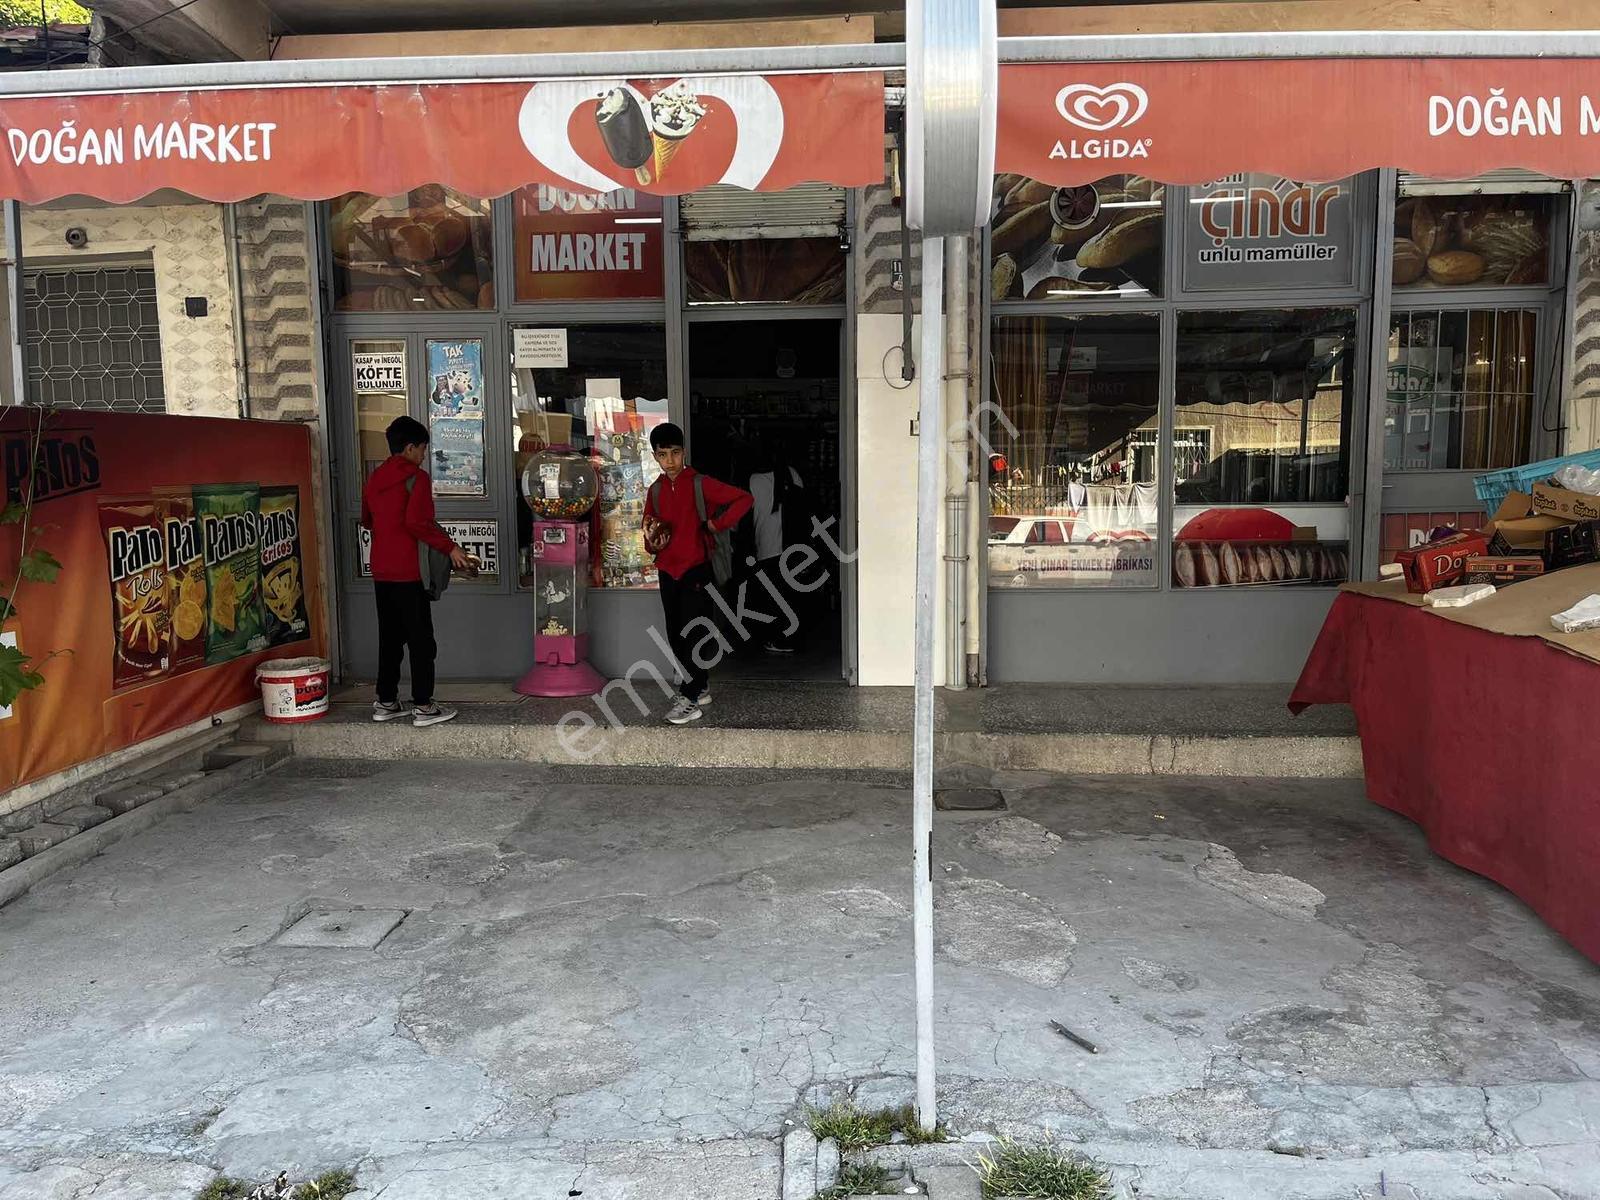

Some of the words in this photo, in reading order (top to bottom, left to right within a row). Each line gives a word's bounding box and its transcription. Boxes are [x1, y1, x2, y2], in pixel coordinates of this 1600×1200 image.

[1429, 87, 1562, 136] DOĞAN
[8, 120, 123, 167] DOĞAN
[134, 121, 277, 163] MARKET
[532, 233, 646, 272] MARKET
[1200, 248, 1240, 262] unlu
[1247, 245, 1336, 261] mamüller
[356, 356, 373, 364] KASAP
[382, 355, 402, 364] İNEGÖL
[443, 345, 464, 358] TAK
[356, 365, 402, 380] KÖFTE
[357, 380, 402, 389] BULUNUR
[459, 528, 467, 536] ve
[469, 525, 496, 536] İNEGÖL
[461, 541, 496, 559] FTE
[1071, 558, 1102, 571] EKMEK
[1105, 555, 1153, 571] FABRİKASI
[126, 569, 163, 600] Rolls
